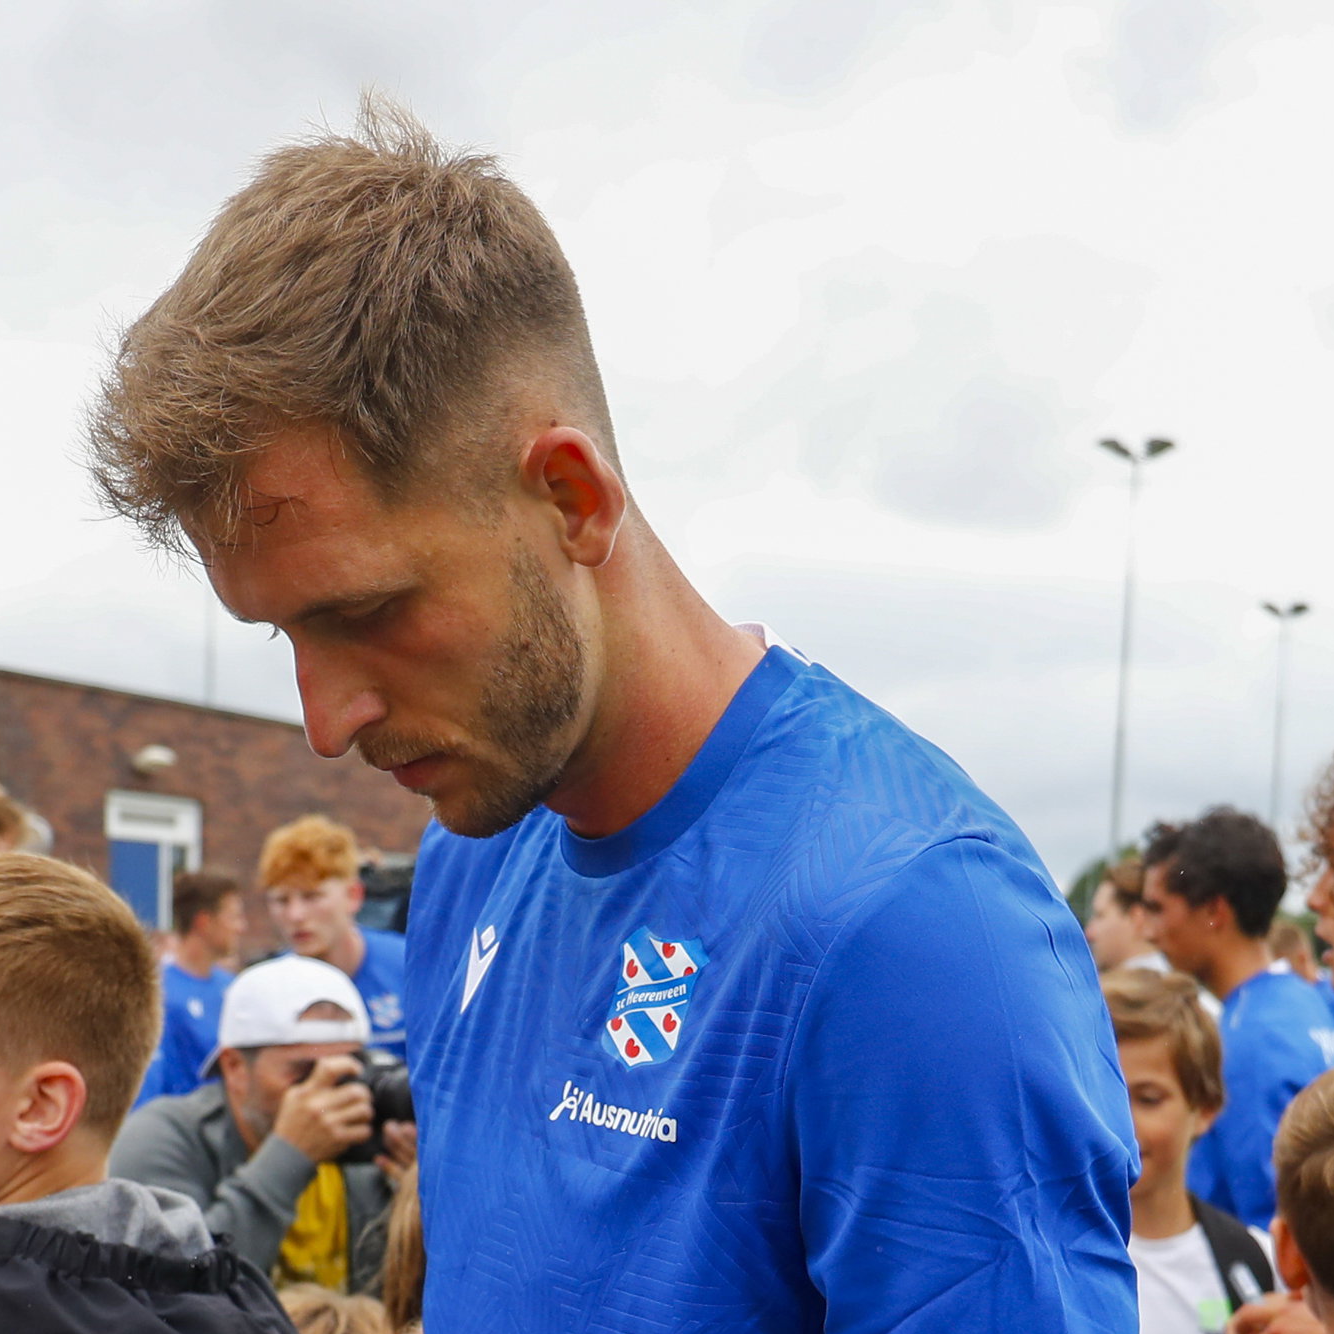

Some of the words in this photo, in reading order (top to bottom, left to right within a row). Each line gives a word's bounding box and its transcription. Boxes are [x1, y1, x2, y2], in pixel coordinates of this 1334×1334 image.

[616, 998, 626, 1011] sc
[627, 984, 687, 1006] Heerenveen
[579, 1093, 677, 1142] Ausnutria
